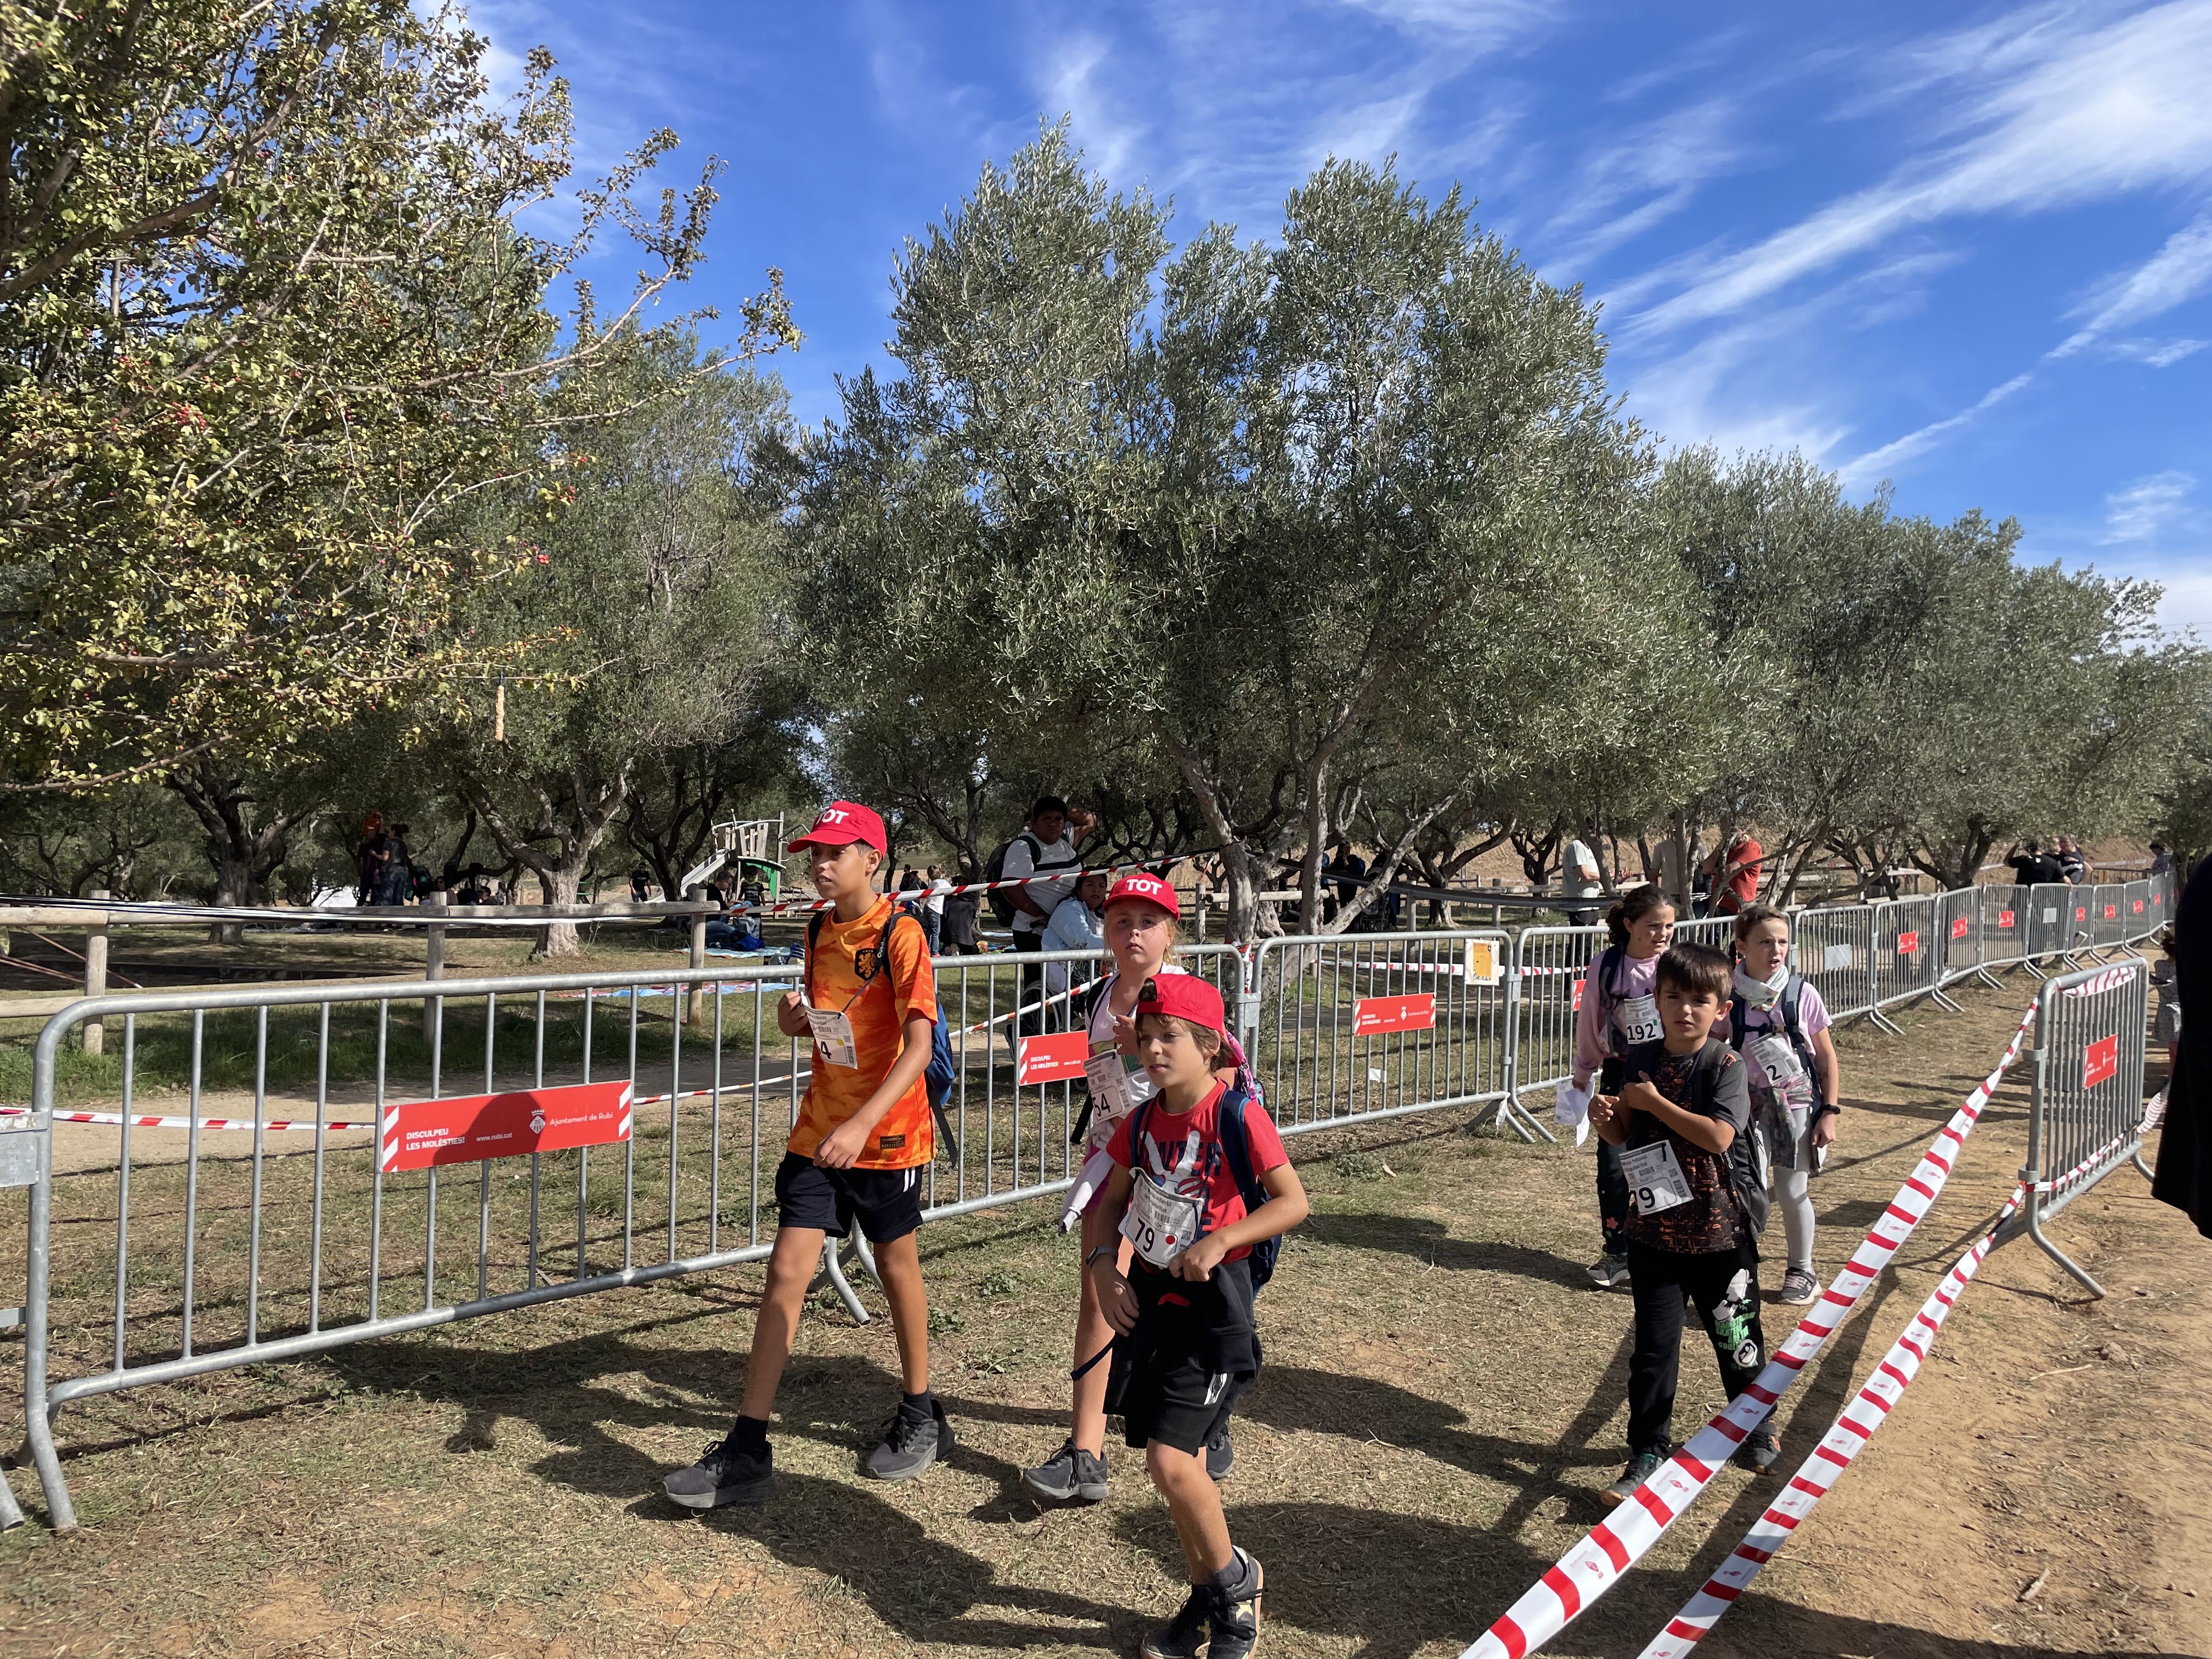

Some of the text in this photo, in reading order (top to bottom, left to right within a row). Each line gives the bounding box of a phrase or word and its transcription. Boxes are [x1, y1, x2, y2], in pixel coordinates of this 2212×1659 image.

[1126, 878, 1163, 895] TOT
[1627, 1023, 1656, 1040] 192
[1766, 1064, 1782, 1080] 2
[549, 1114, 588, 1127] Ajuntament
[589, 1113, 597, 1121] de
[406, 1128, 449, 1140] DISCULPEU
[406, 1136, 465, 1150] LES MOLÈSTIES!
[1135, 1217, 1155, 1252] 79
